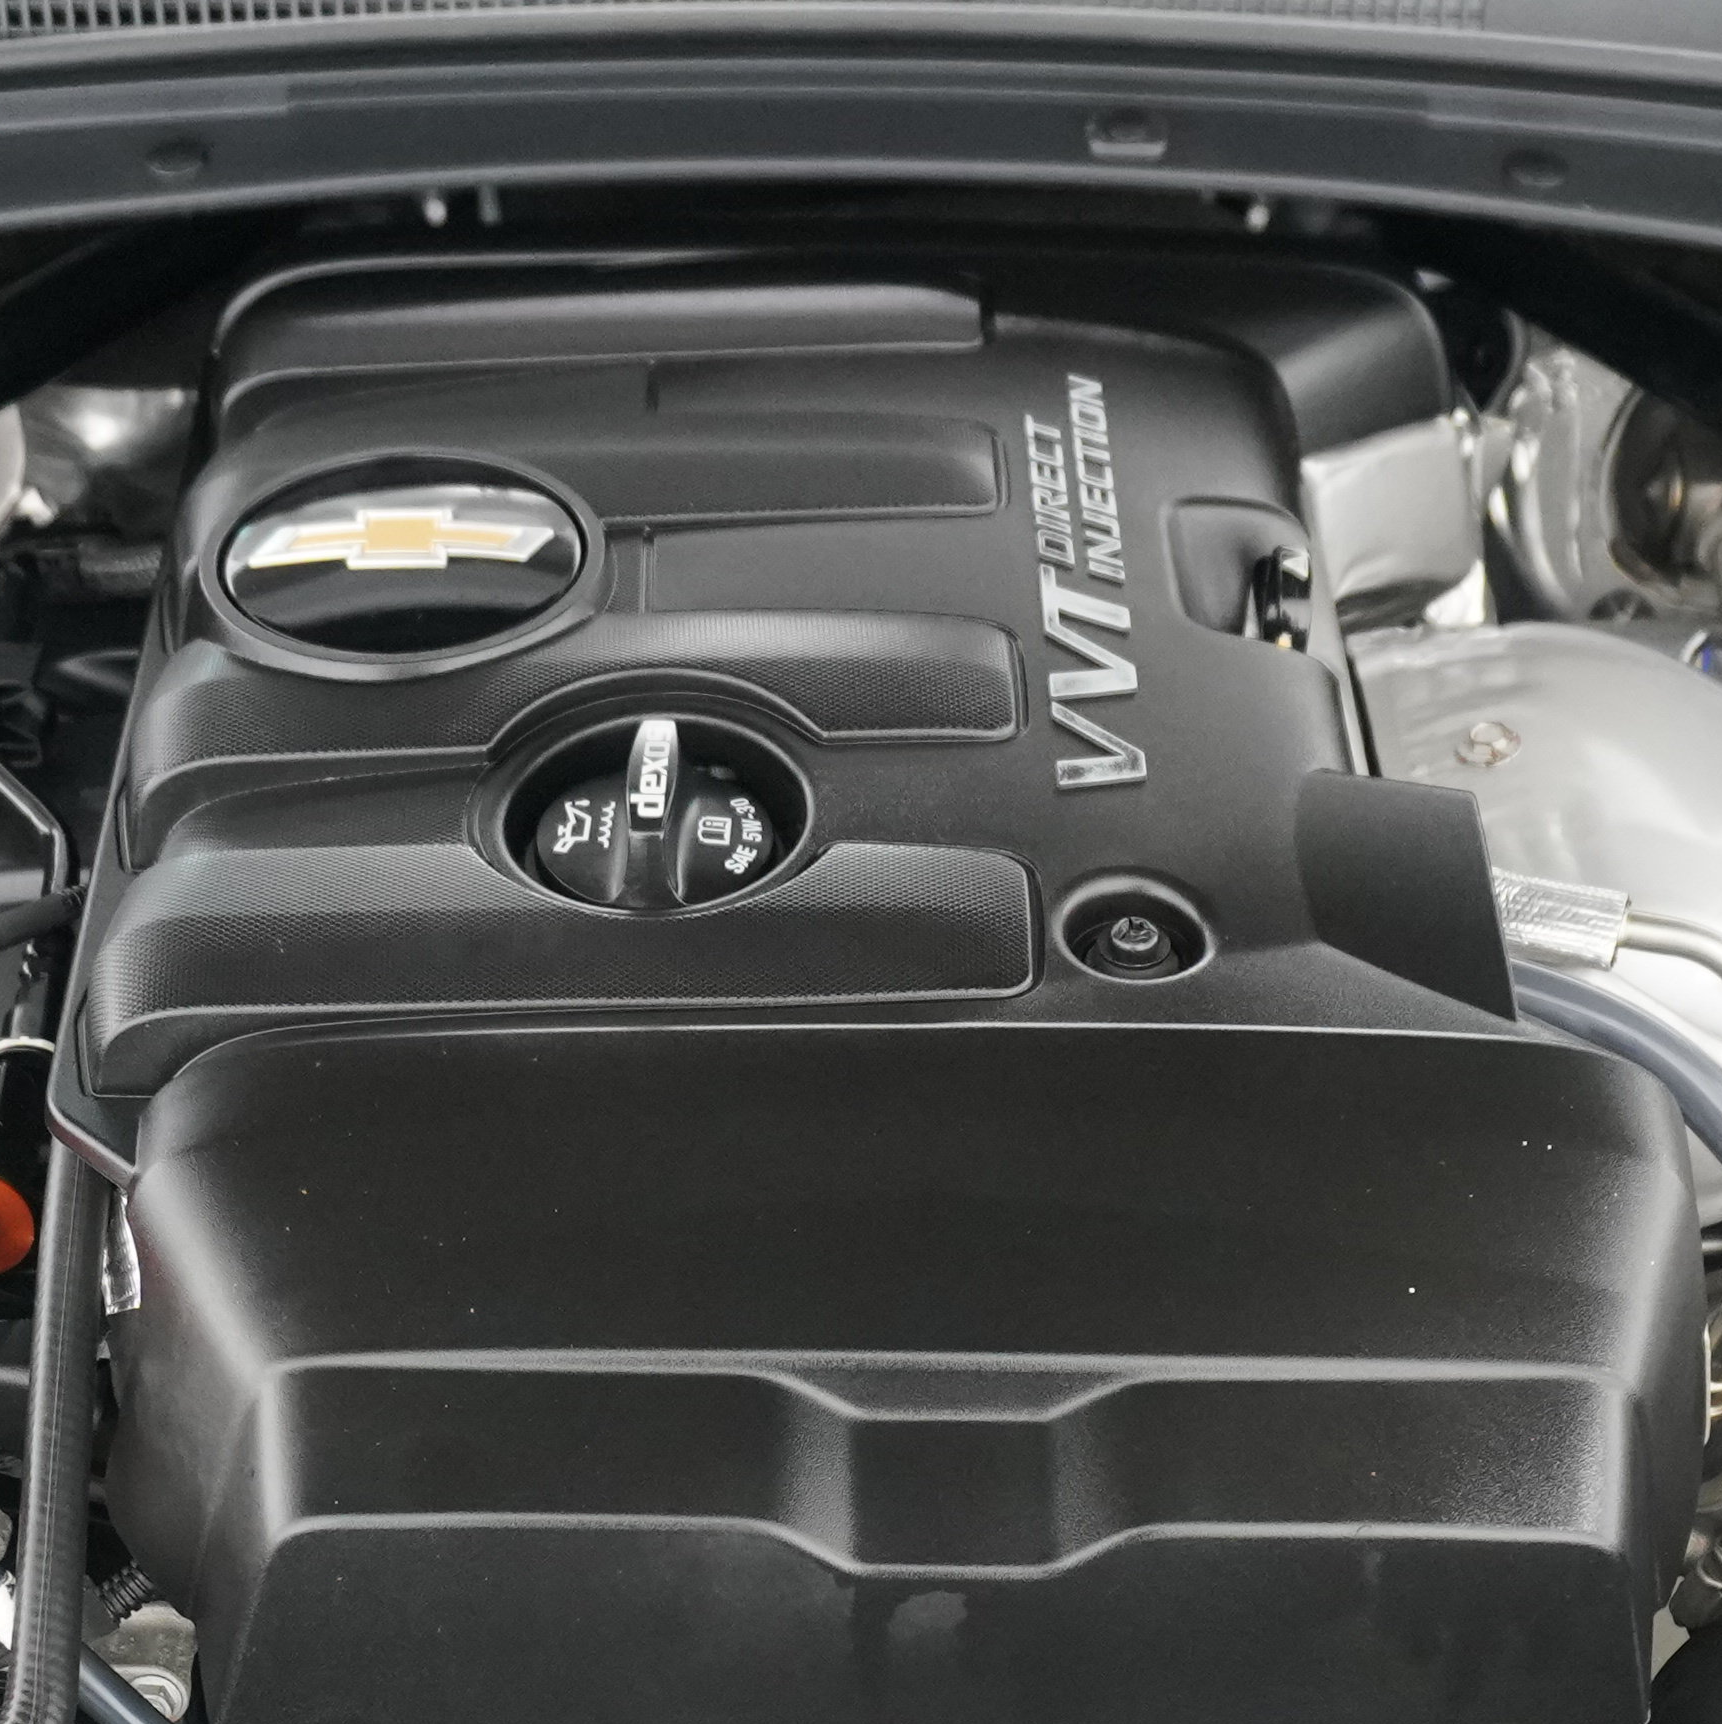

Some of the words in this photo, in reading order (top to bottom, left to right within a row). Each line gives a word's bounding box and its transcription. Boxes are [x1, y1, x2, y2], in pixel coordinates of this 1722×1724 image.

[1024, 413, 1075, 569] DIRECT
[1067, 373, 1125, 583] INJECTION
[1040, 563, 1147, 790] VVT
[724, 844, 758, 875] SAE
[729, 797, 763, 843] 5W-30
